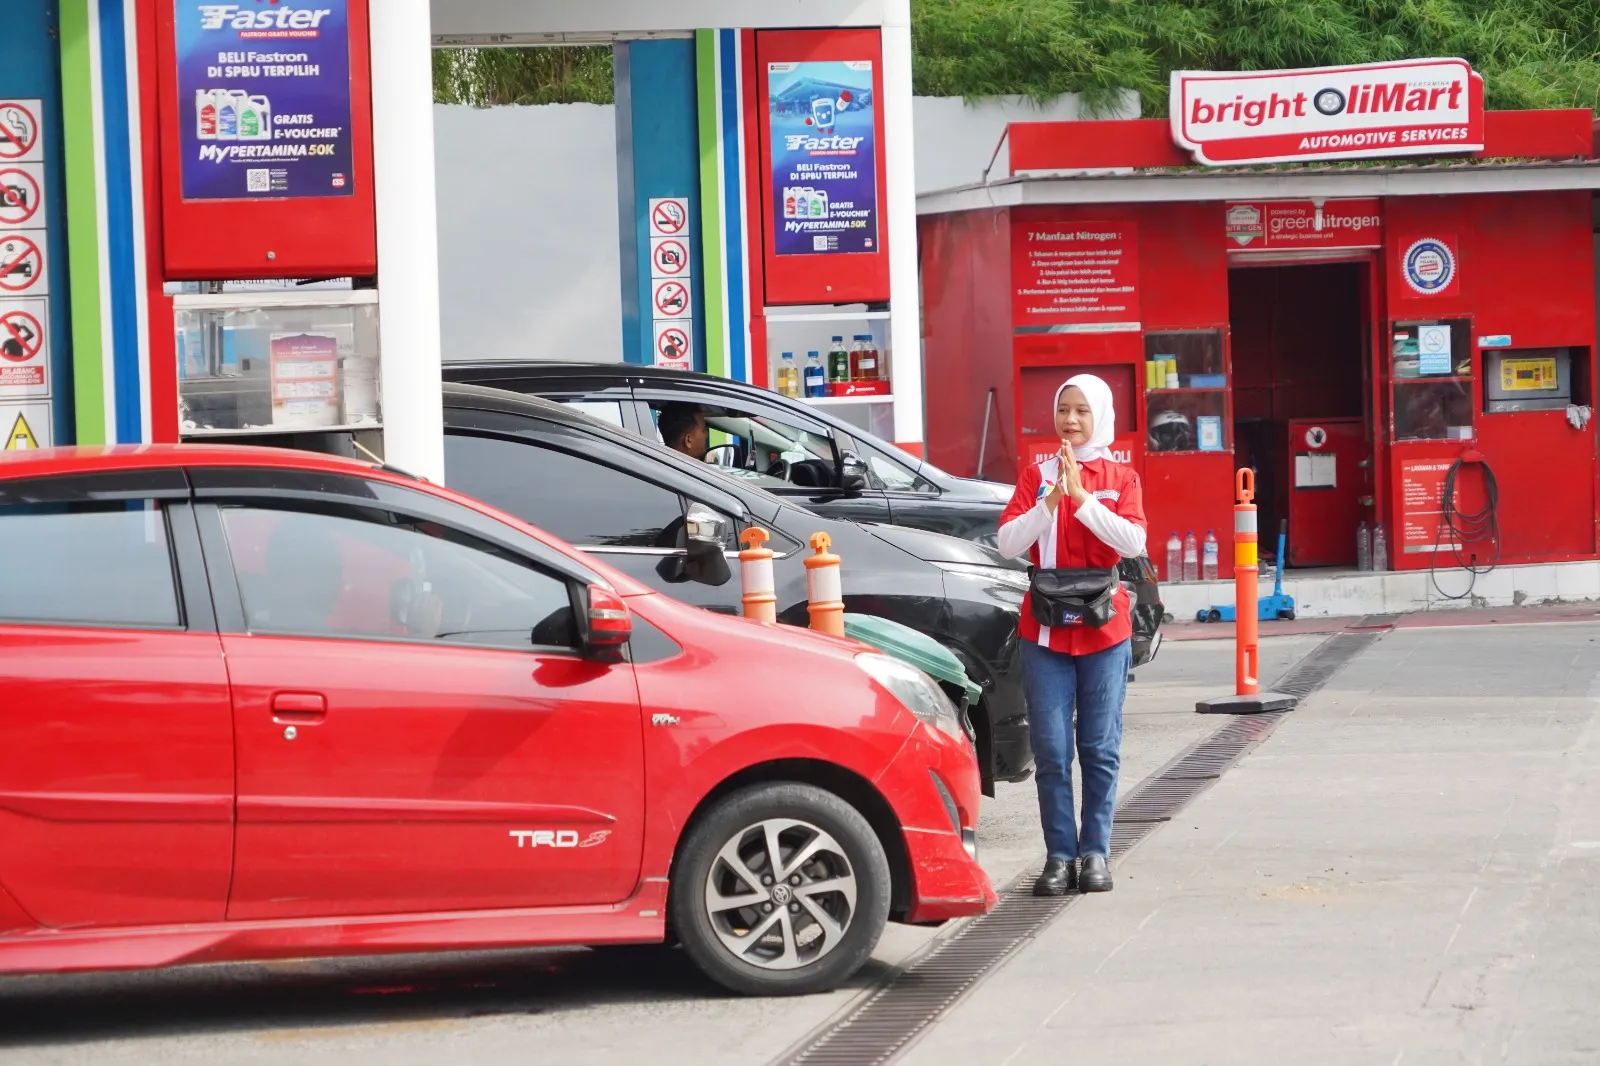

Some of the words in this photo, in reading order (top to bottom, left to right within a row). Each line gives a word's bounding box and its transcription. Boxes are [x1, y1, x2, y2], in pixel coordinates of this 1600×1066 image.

[198, 4, 330, 30] Faster
[218, 52, 245, 63] BELI
[248, 52, 308, 63] Fastron
[207, 66, 223, 78] DI
[224, 66, 260, 78] SPBU
[264, 64, 320, 76] TERPILIH
[1191, 92, 1307, 126] bright
[274, 114, 314, 125] GRATIS
[785, 134, 864, 150] Faster
[1298, 132, 1396, 150] AUTOMOTIVE
[1400, 128, 1468, 144] SERVICES
[308, 144, 335, 156] 50K
[796, 164, 813, 172] BELI
[790, 172, 799, 180] DI
[800, 172, 822, 180] SPBU
[824, 172, 858, 180] TERPILIH
[830, 202, 854, 210] GRATIS
[850, 220, 867, 228] 50K
[1028, 232, 1034, 241] 7
[1036, 232, 1074, 241] Manfaat
[1076, 232, 1116, 242] Nitrogen
[509, 830, 579, 848] TRD
